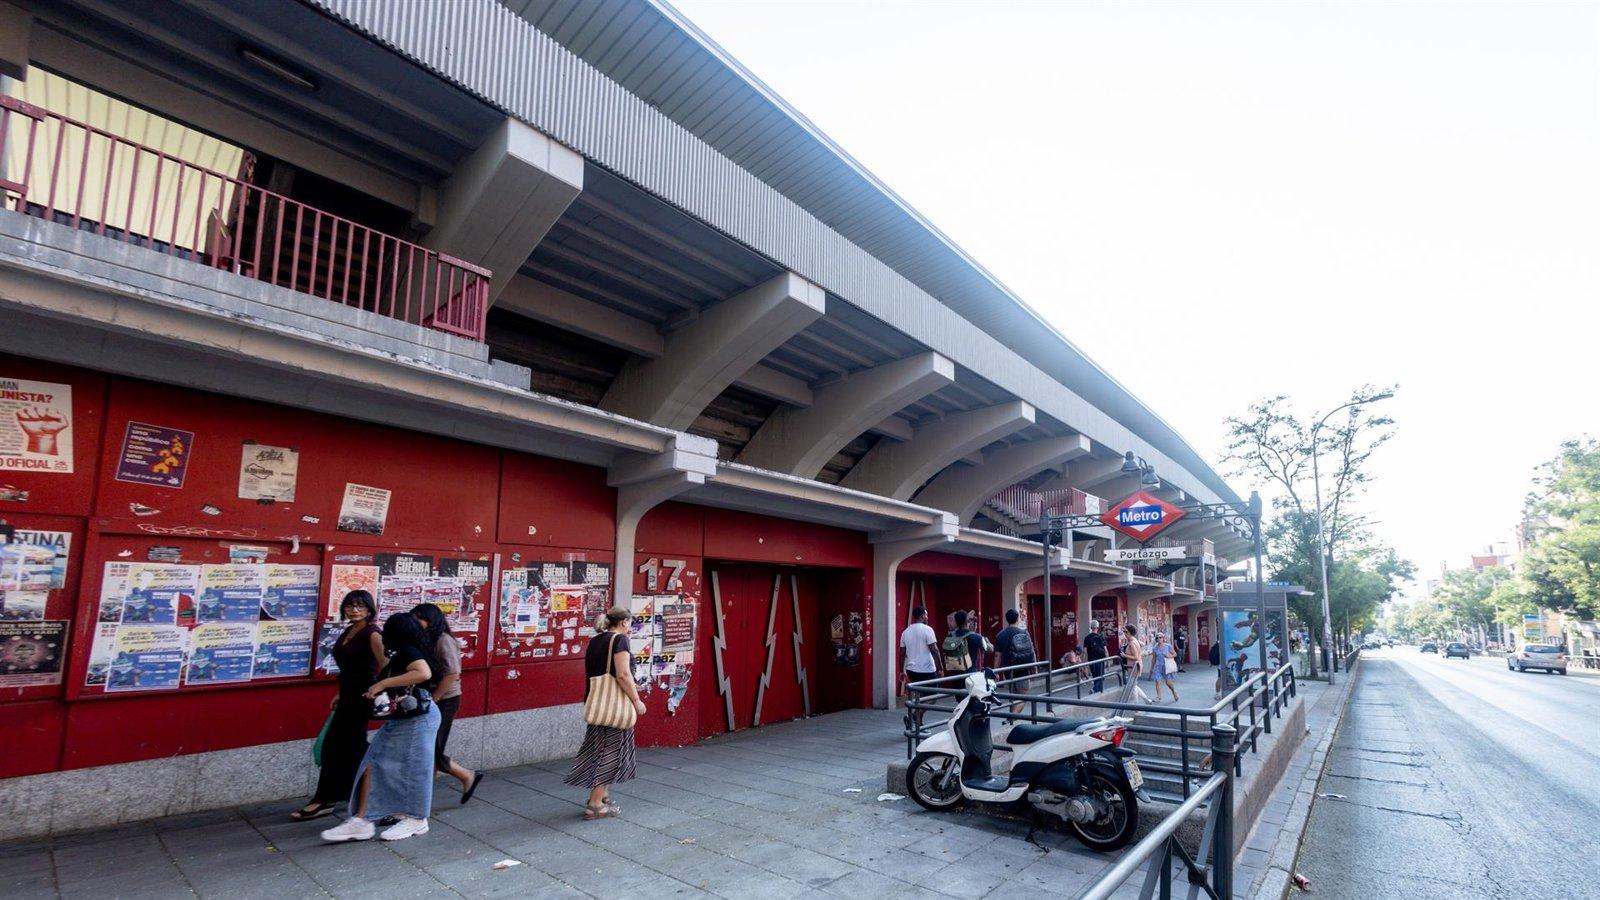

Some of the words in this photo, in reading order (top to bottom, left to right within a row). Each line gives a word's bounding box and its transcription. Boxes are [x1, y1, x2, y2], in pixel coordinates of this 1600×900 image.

[6, 458, 49, 468] OFICIAL
[1122, 511, 1159, 522] Metro
[1120, 550, 1168, 559] Portazgo
[396, 561, 430, 574] GUERRA
[458, 565, 488, 578] GUERRA
[639, 558, 686, 591] 17
[653, 654, 675, 665] paz
